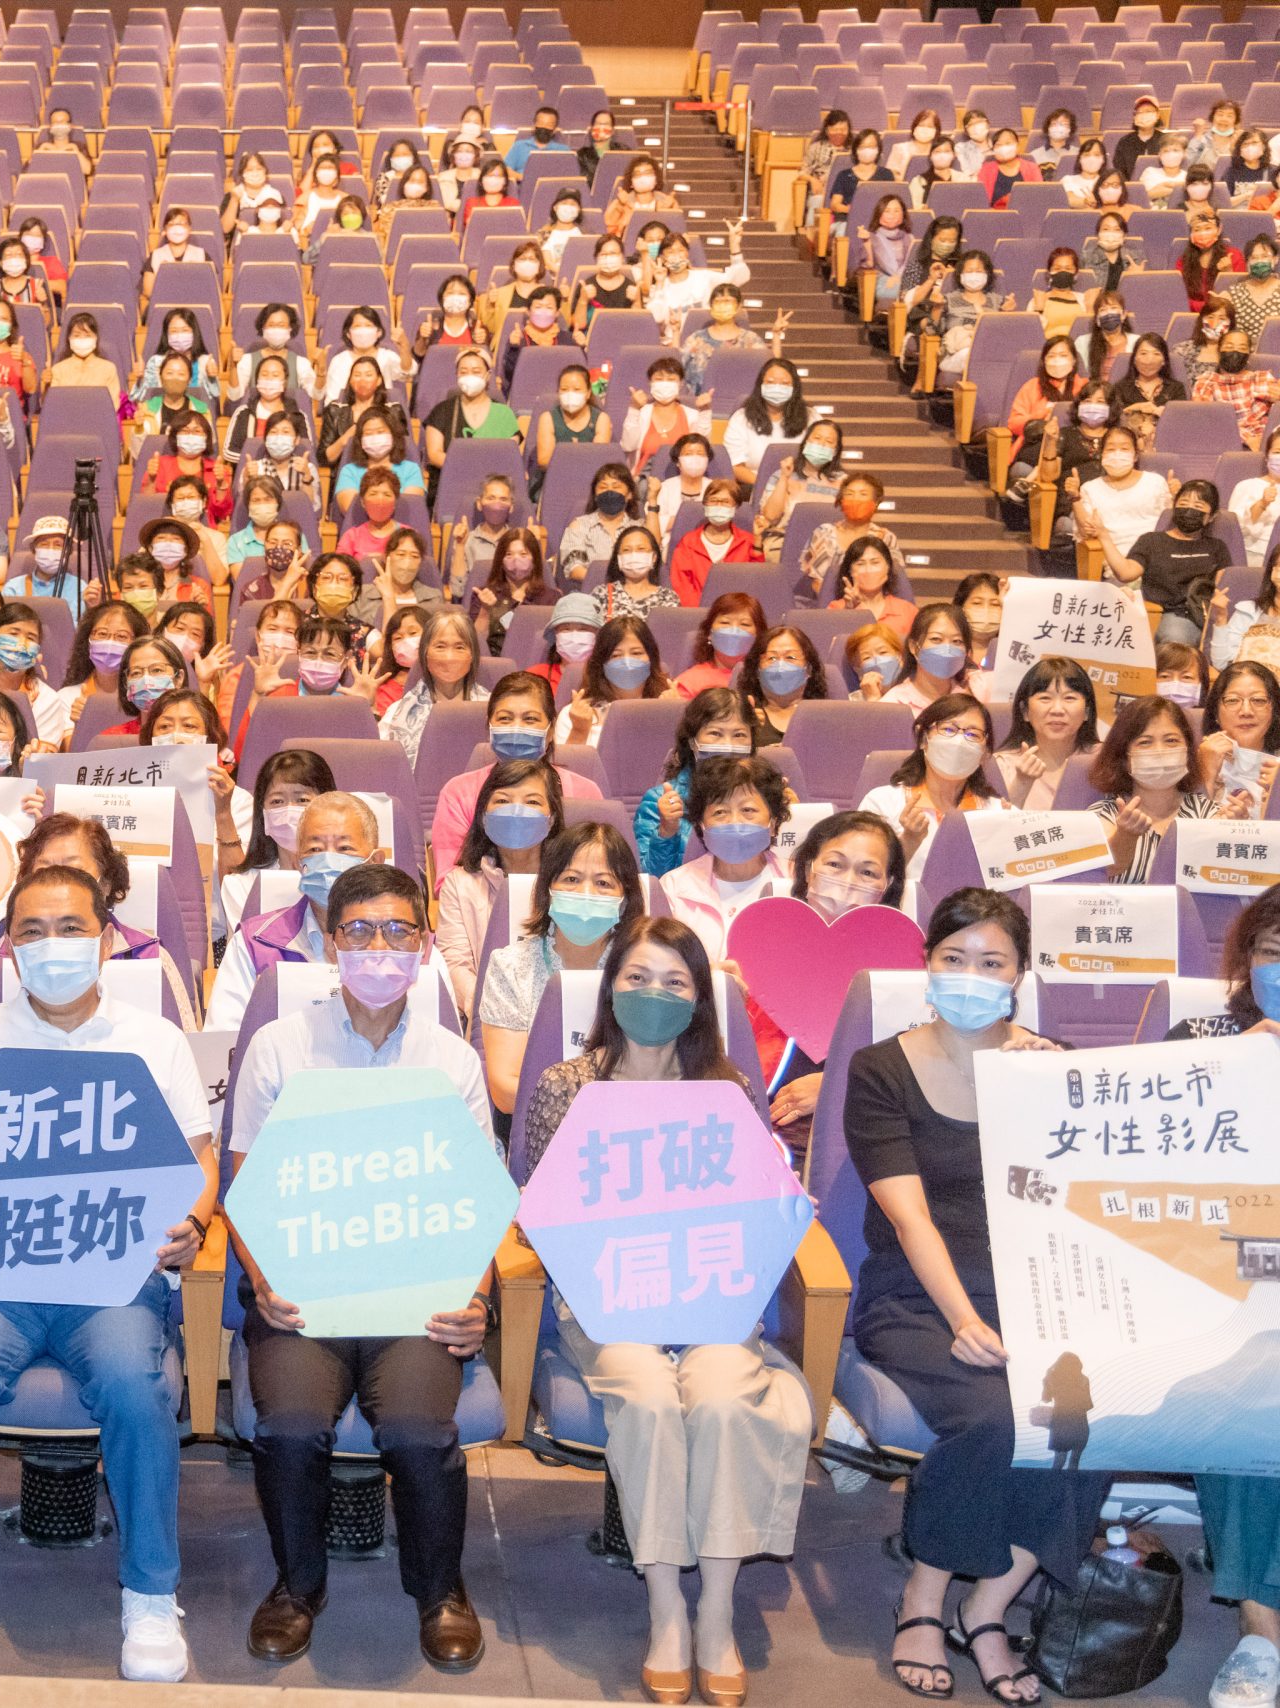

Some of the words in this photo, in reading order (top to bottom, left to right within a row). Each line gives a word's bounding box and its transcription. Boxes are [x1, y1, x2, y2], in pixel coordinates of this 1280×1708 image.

[1065, 595, 1127, 622] 新北市
[1033, 620, 1135, 650] 女性影展
[90, 761, 163, 787] 新北市
[1014, 825, 1064, 852] 貴賓席
[1216, 842, 1269, 860] 貴賓席
[1075, 926, 1133, 944] 貴賓席
[1093, 1064, 1212, 1107] 新北市
[1046, 1110, 1249, 1159] 女性影展
[276, 1131, 453, 1198] #Break
[578, 1113, 737, 1208] 打破
[1106, 1197, 1224, 1221] 扎根新北
[1223, 1194, 1274, 1208] 2022
[276, 1194, 477, 1258] TheBias
[593, 1221, 756, 1315] 偏見
